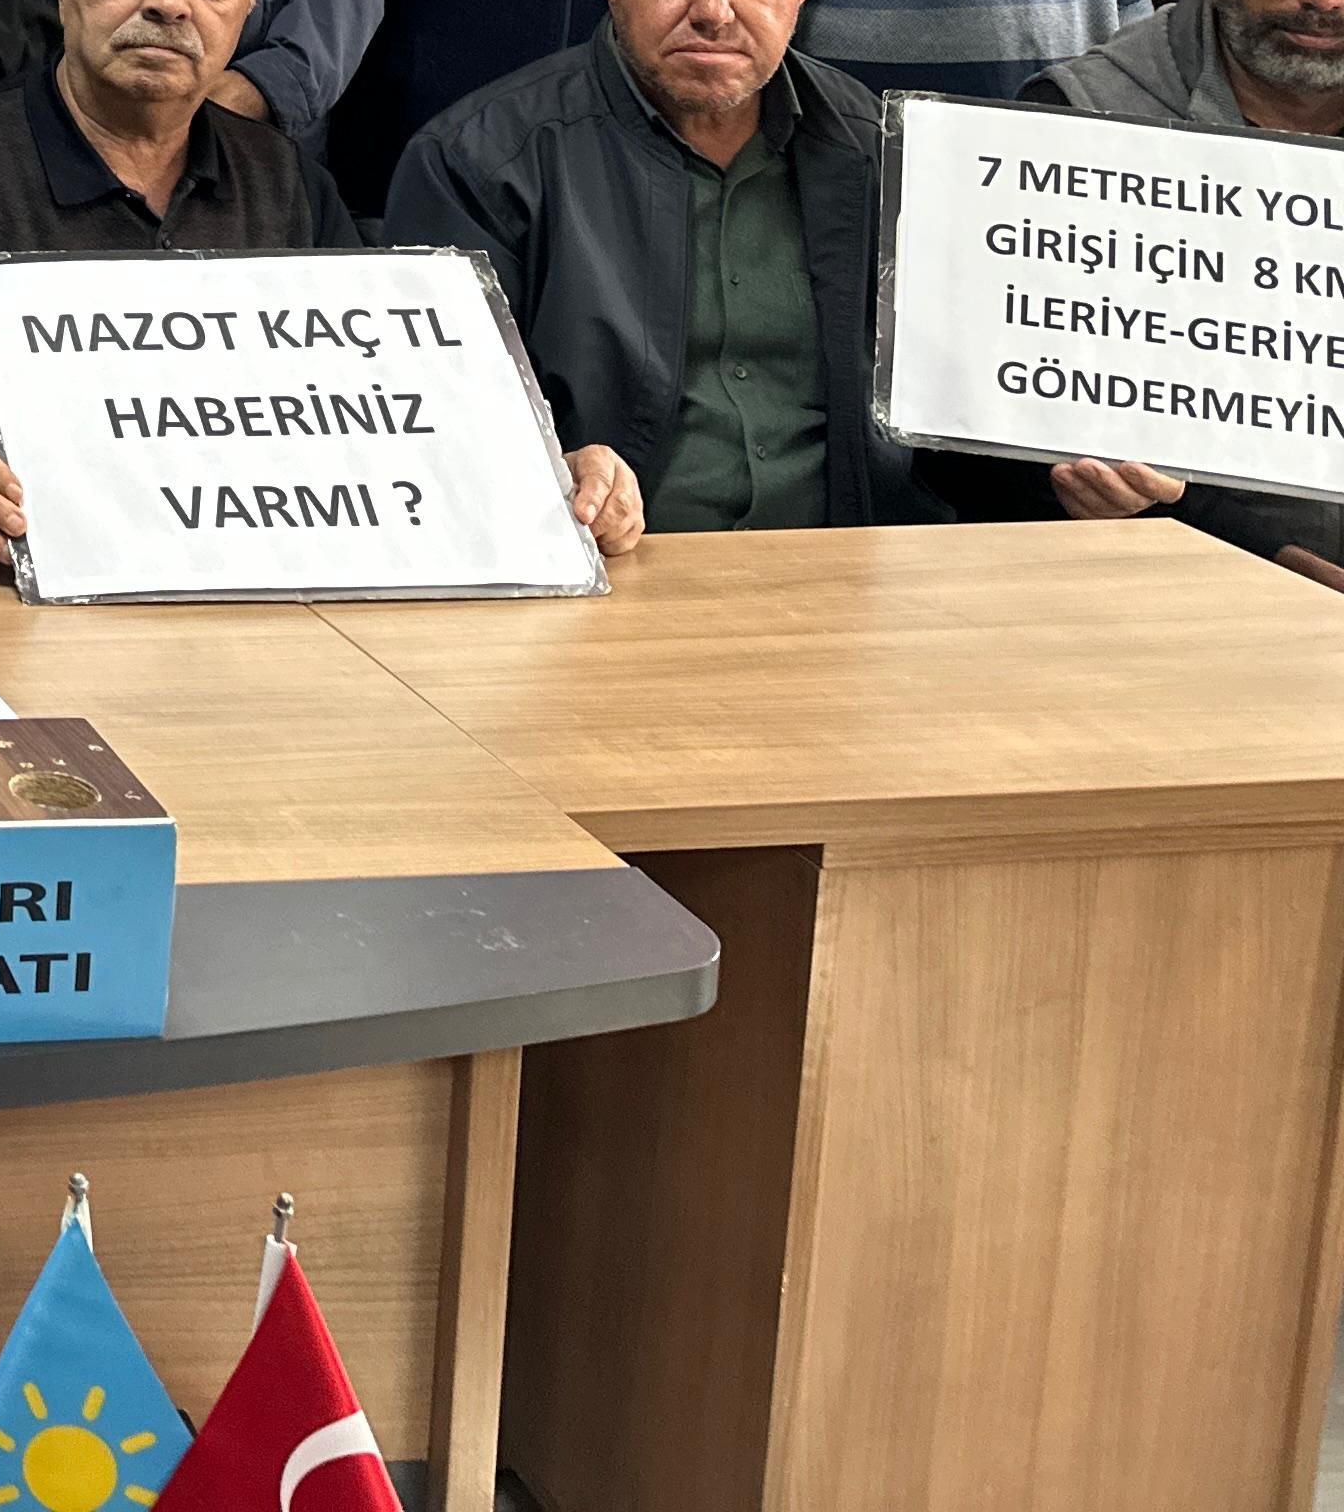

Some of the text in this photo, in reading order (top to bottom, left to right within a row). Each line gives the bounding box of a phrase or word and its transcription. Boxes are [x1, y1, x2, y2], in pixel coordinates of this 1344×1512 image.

[978, 156, 1343, 231] 7 METRELİK YOL
[985, 218, 1116, 274] GİRİŞİ
[1134, 233, 1224, 284] İÇİN
[1253, 256, 1279, 290] 8
[22, 307, 462, 358] MAZOT KAÇ TL
[1005, 284, 1344, 369] İLERİYE-GERİYE
[104, 383, 435, 439] HABERİNİZ
[160, 480, 423, 530] VARMI ?
